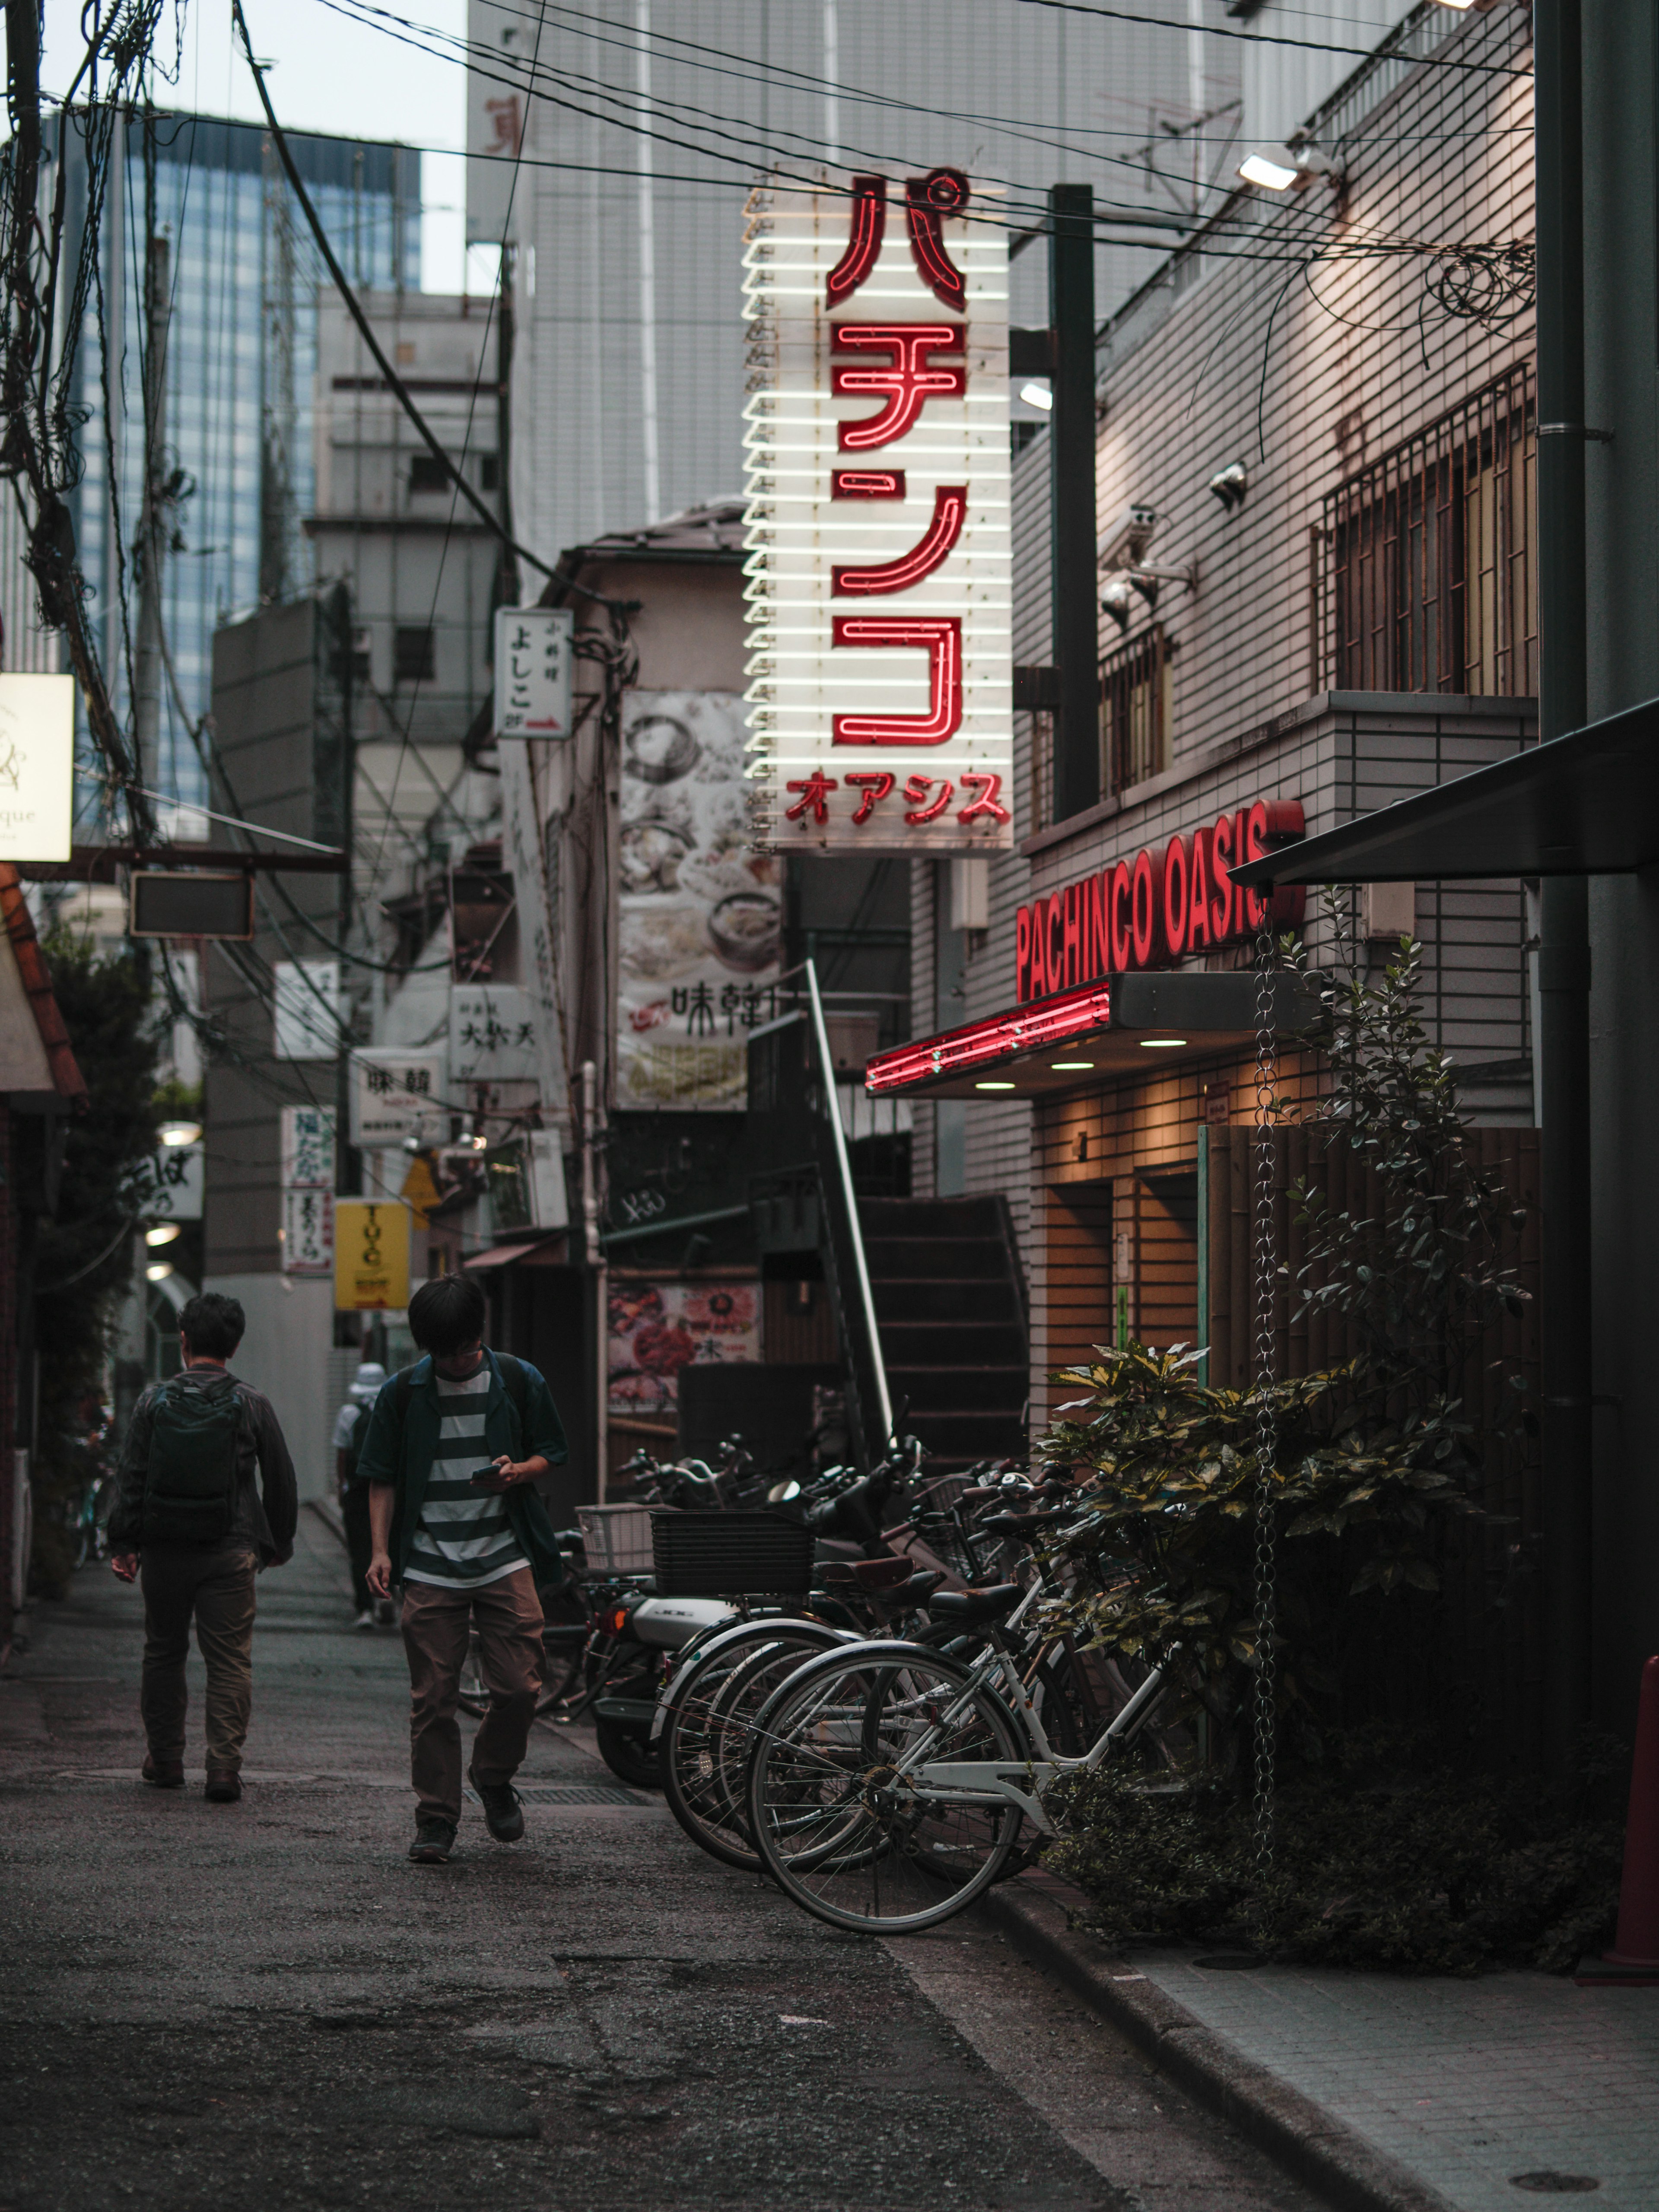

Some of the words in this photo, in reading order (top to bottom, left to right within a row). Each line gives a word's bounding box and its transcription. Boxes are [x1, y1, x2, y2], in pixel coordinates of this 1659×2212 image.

[826, 167, 970, 747] パチンコ
[511, 624, 533, 708] よしこ
[785, 772, 1011, 825] オアシス
[1017, 848, 1155, 1004] PACHINCO
[1164, 799, 1279, 956] OASIS
